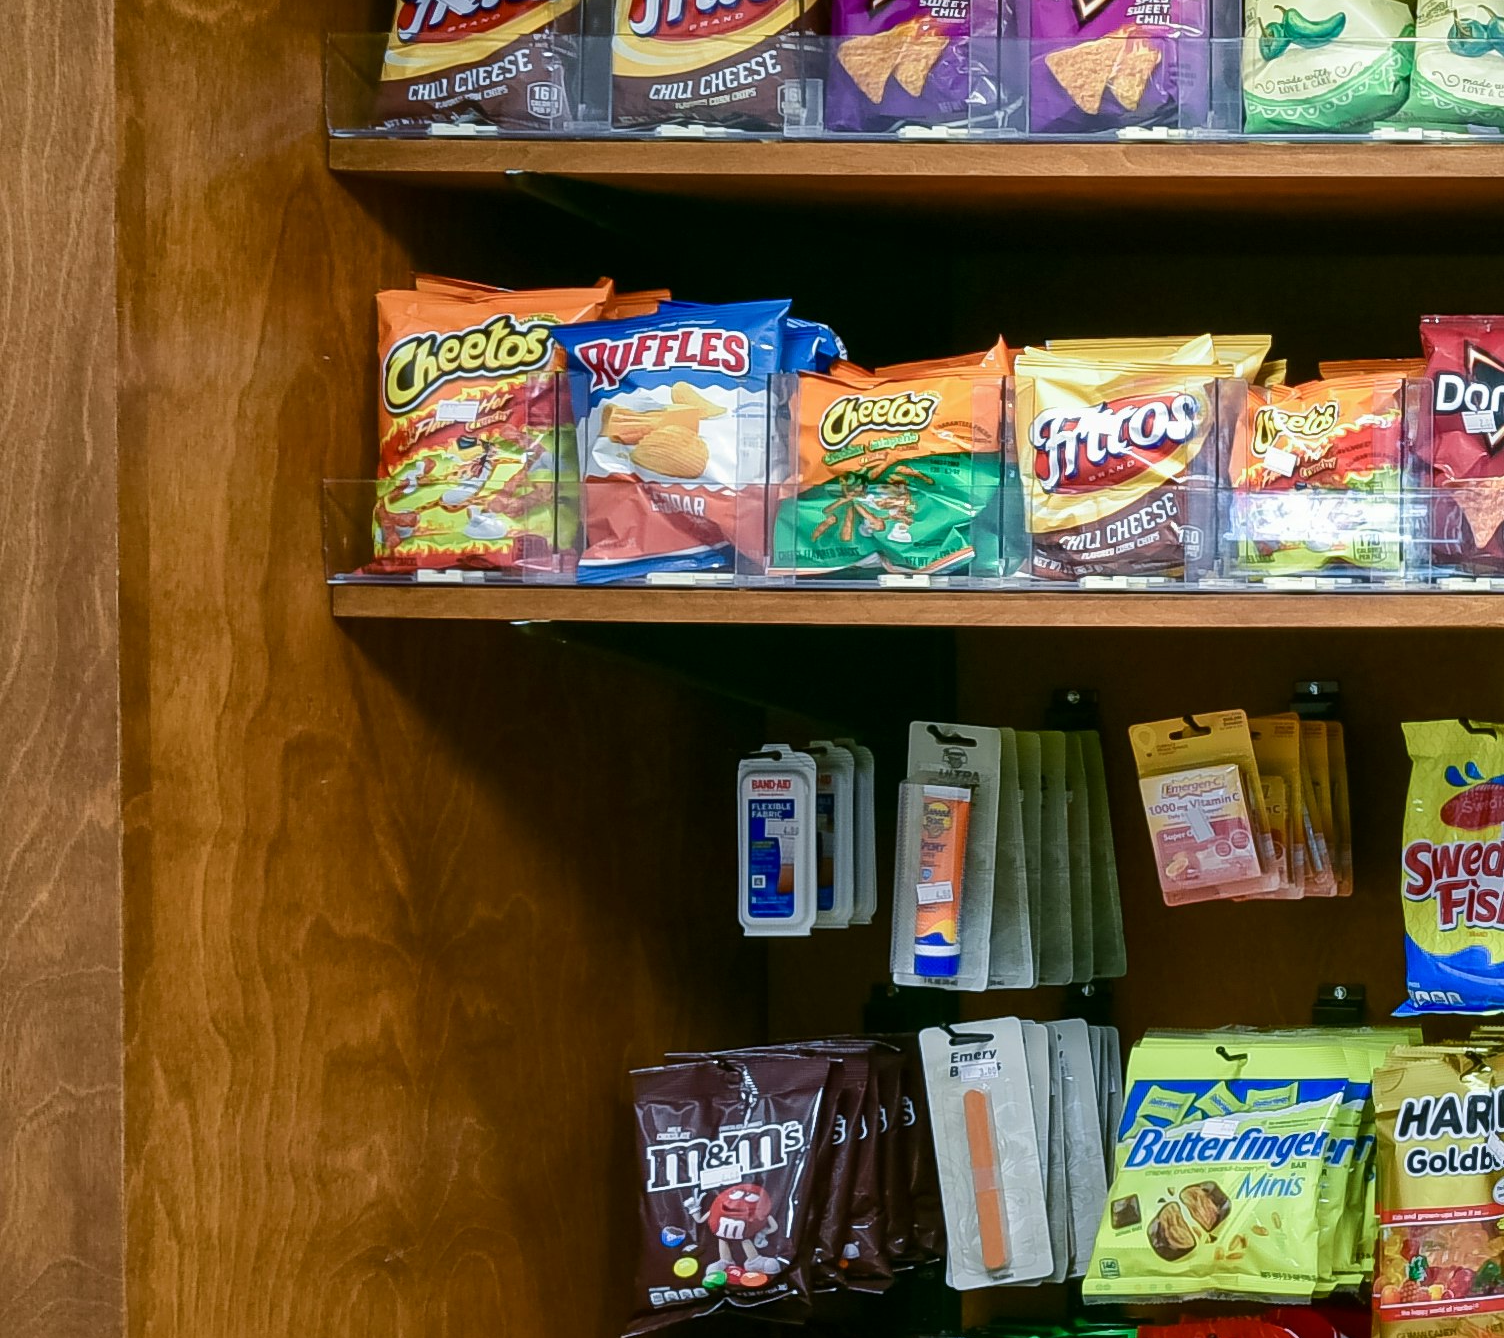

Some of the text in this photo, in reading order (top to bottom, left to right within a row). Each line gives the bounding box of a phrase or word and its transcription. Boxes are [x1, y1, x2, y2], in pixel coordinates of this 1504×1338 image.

[1136, 14, 1171, 25] CHILI
[649, 80, 695, 101] CHILI
[699, 52, 781, 97] CHEESE
[387, 321, 550, 411] Cheetos
[577, 331, 749, 390] RUFFLES
[821, 393, 935, 446] Cheetos
[751, 779, 792, 791] BAND-AID
[751, 802, 792, 811] FLEXIBLE
[949, 1049, 998, 1065] Emery
[1126, 1126, 1324, 1169] Butterfinger
[1237, 1172, 1304, 1200] Minis
